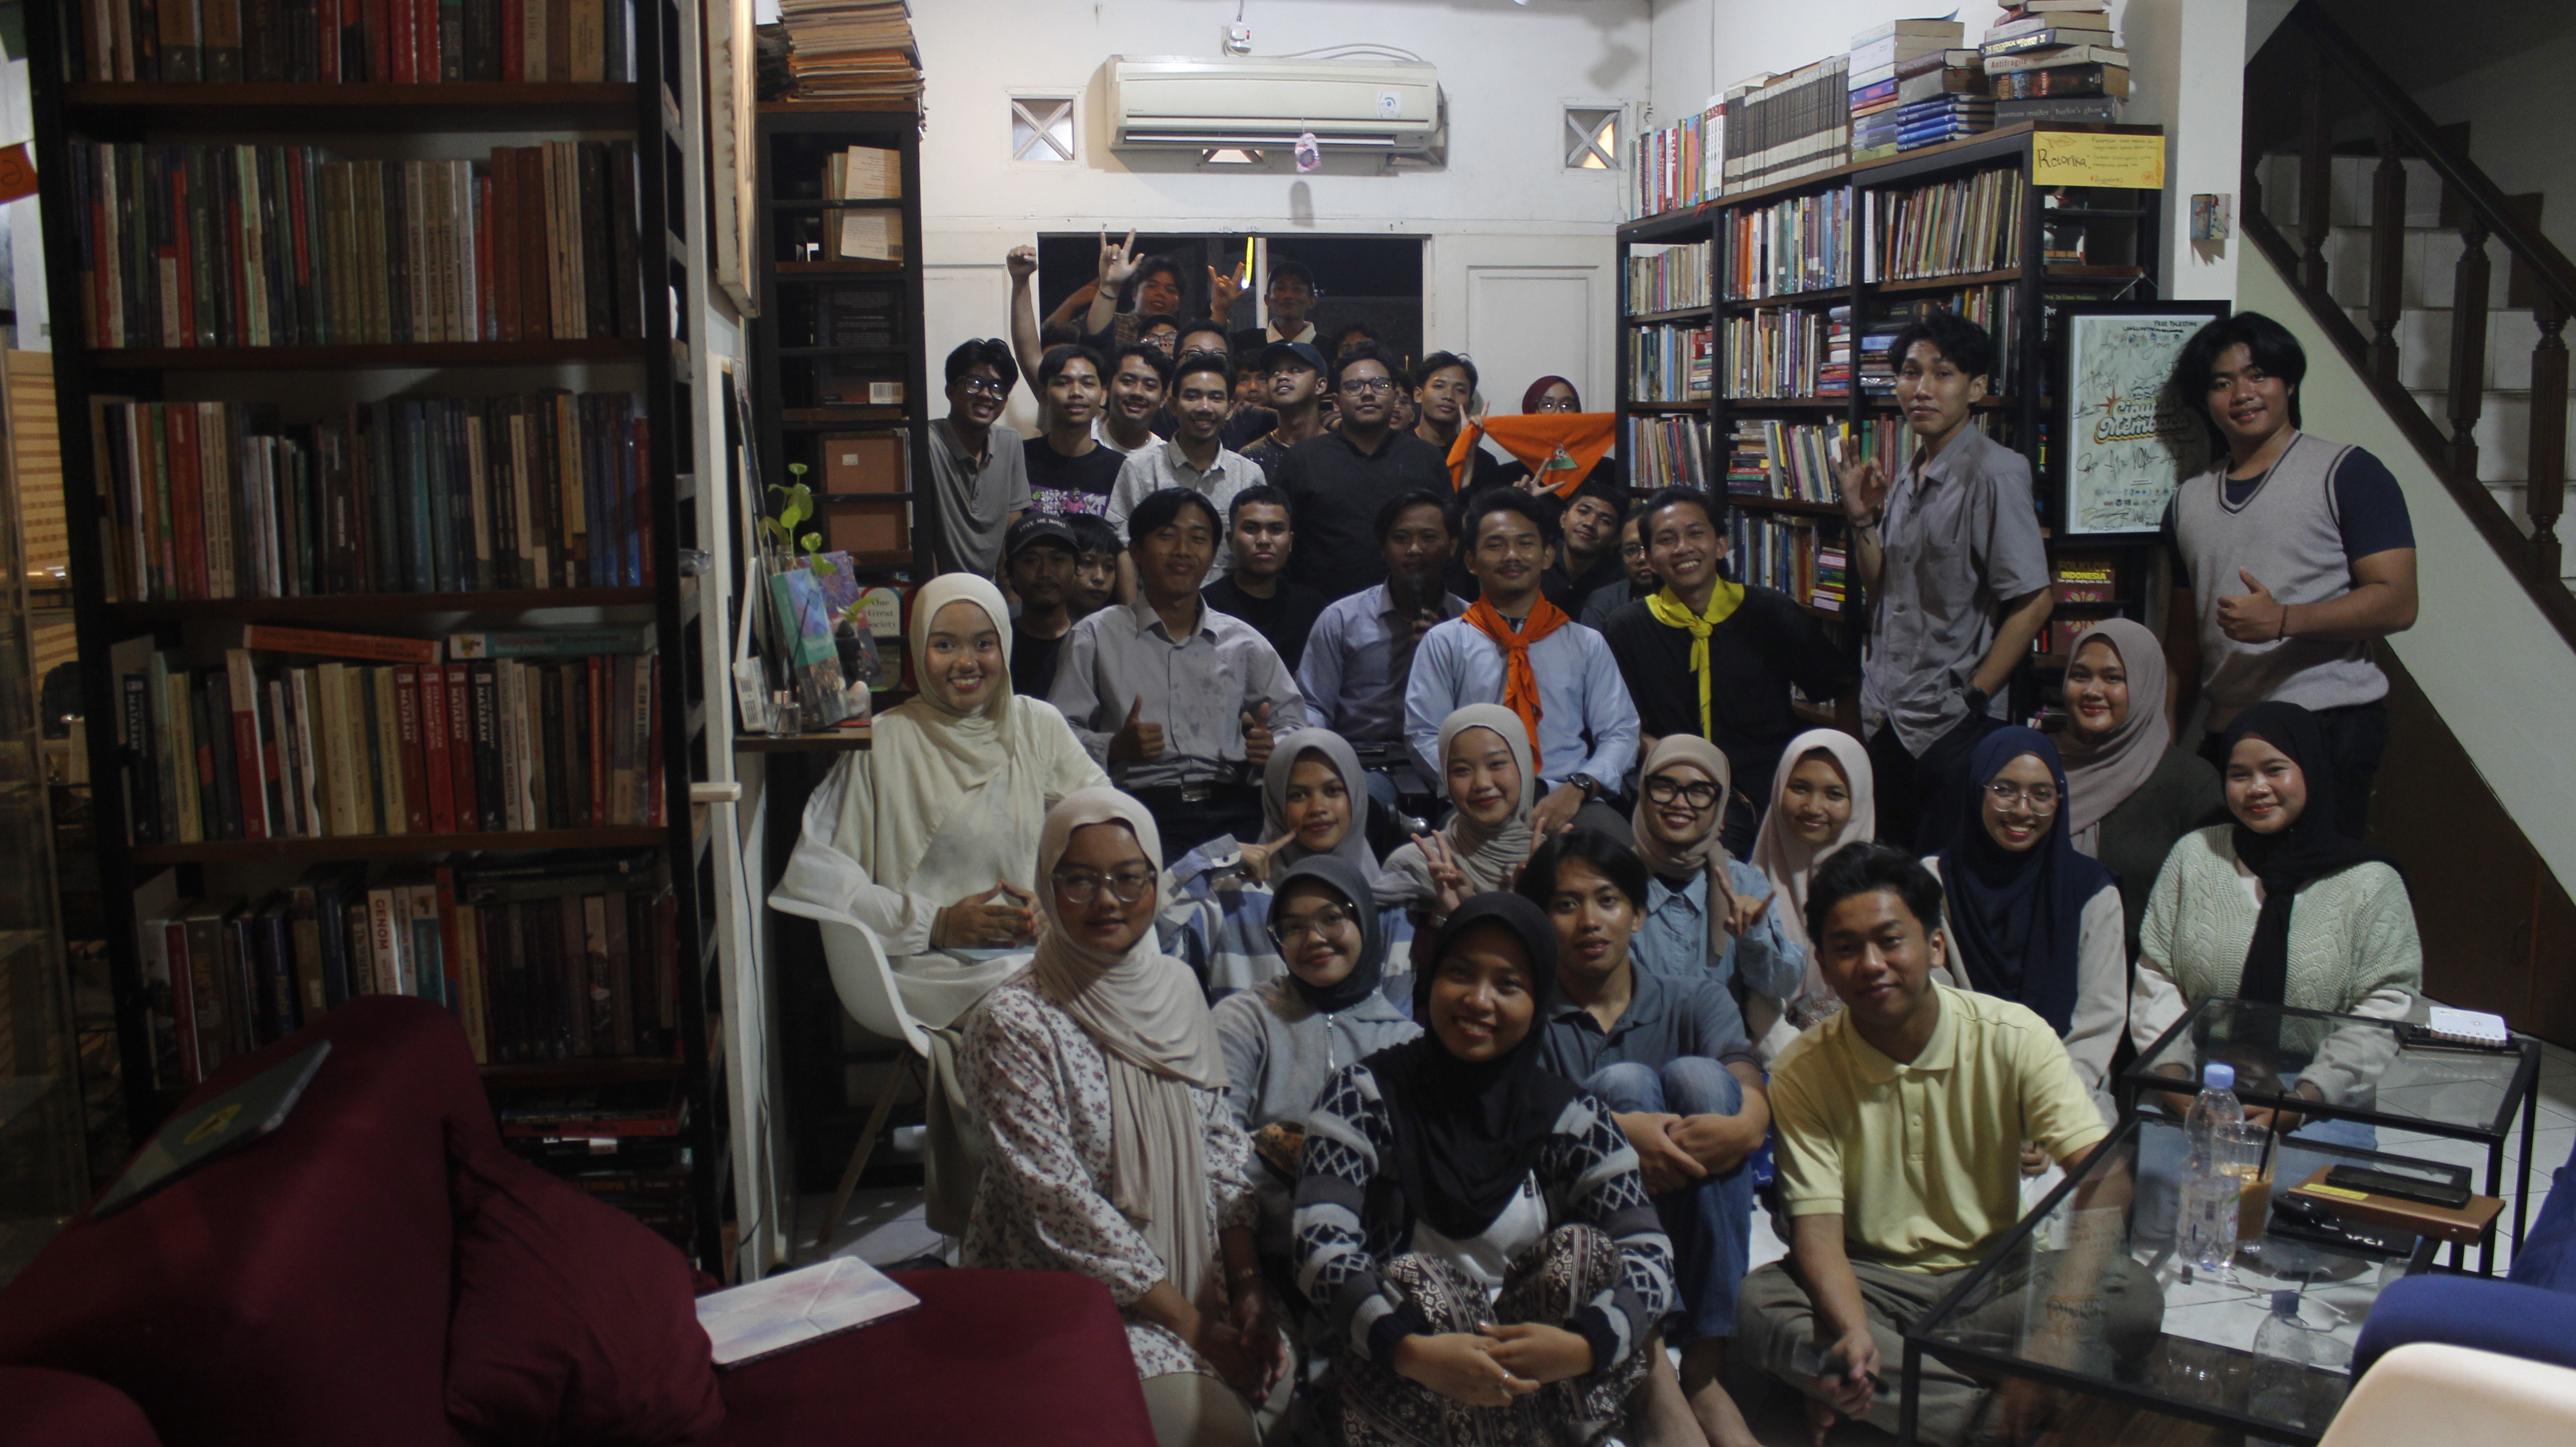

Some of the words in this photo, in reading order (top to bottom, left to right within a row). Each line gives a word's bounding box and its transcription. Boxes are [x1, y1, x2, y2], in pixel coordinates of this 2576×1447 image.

[1991, 58, 2027, 69] Antifragile
[2084, 107, 2103, 116] ghost
[411, 225, 421, 274] SEMIOTIKA
[427, 227, 437, 274] SEMIOTIKA
[443, 224, 452, 270] SEMIOTIKA
[445, 273, 454, 315] NEGATIVA
[2097, 416, 2189, 439] Membaca
[1019, 520, 1034, 532] LOVE
[2058, 561, 2111, 572] FOLKLOR
[2061, 571, 2106, 579] INDONESIA
[128, 694, 140, 751] MATARAM
[399, 689, 411, 740] MATARAM
[425, 686, 433, 720] PERTAMA
[432, 686, 442, 725] KERAJAAN
[450, 688, 462, 739] MATARAM
[476, 686, 488, 742] MATARAM
[503, 719, 514, 764] SEMIOTIKA
[506, 766, 515, 806] NEGATIVA
[355, 929, 366, 947] The
[375, 899, 389, 950] GENOM
[356, 947, 369, 968] Wild
[358, 970, 371, 993] Duck
